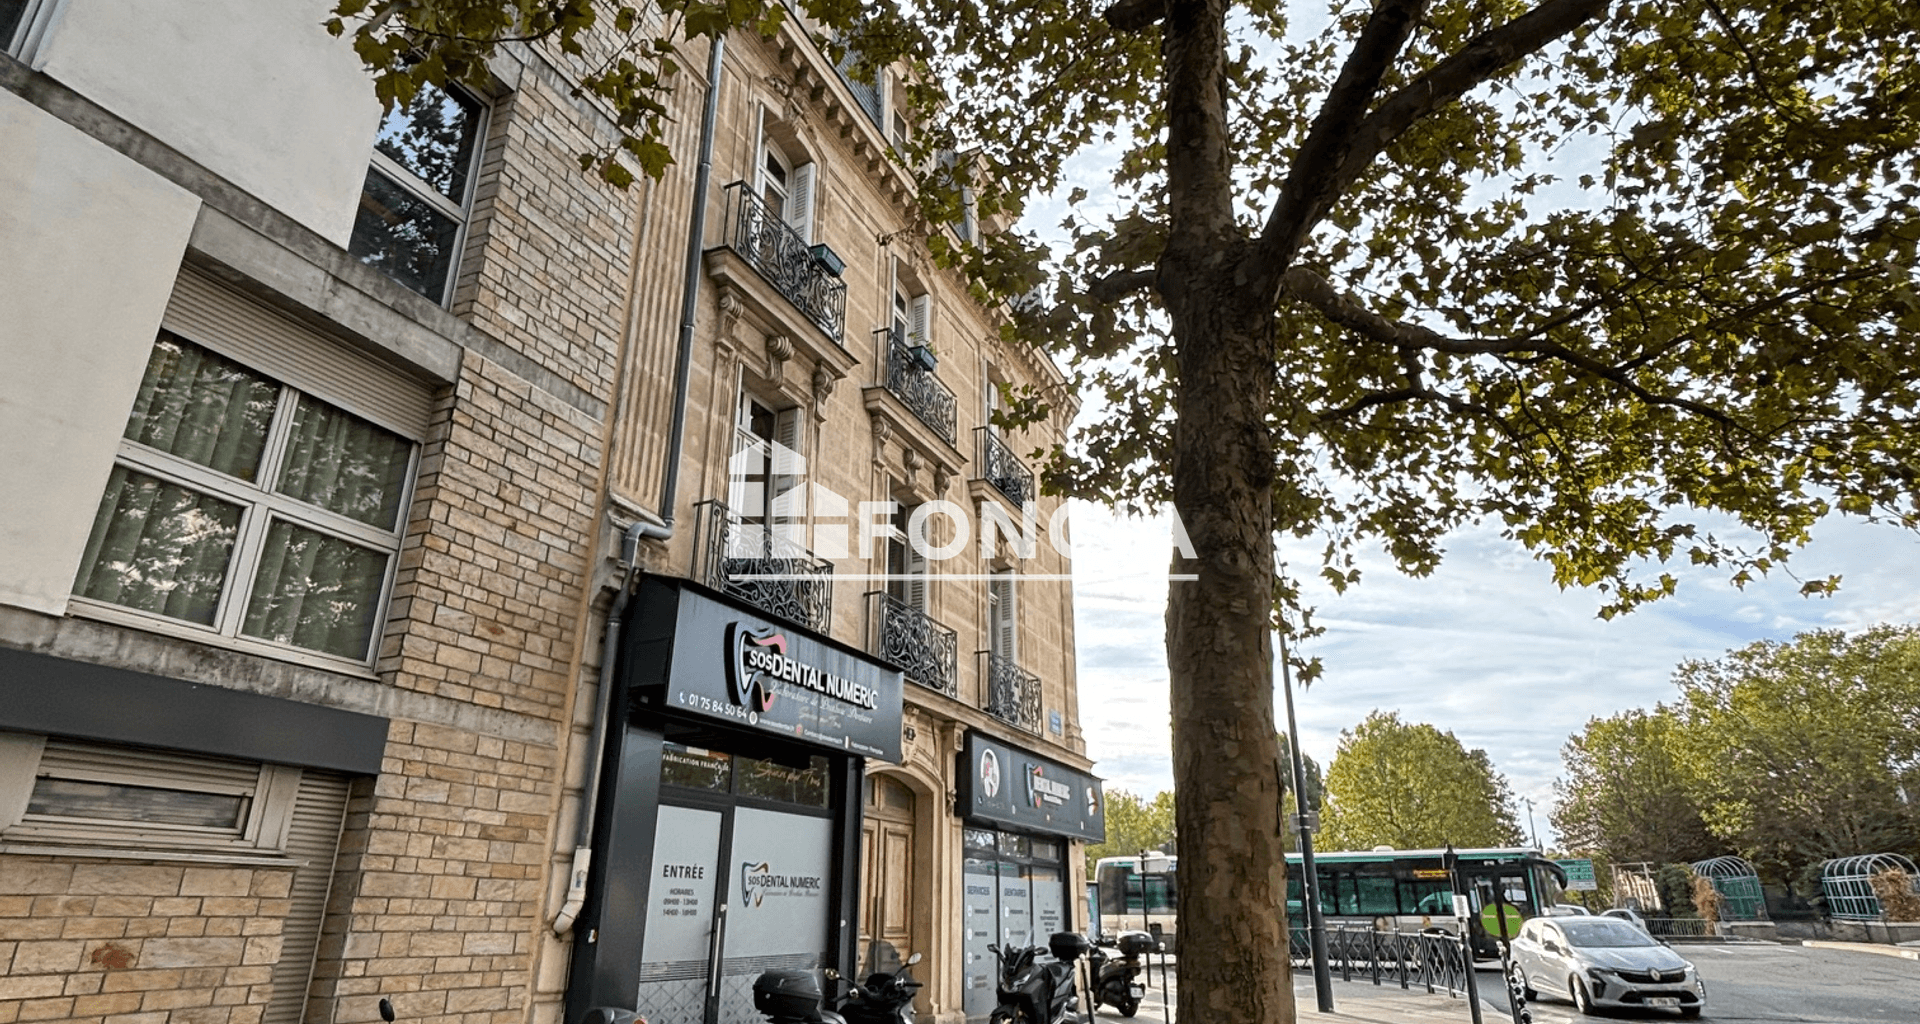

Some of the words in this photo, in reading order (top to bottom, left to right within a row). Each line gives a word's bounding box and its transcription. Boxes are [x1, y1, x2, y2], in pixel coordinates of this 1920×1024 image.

[826, 673, 878, 710] NUMERIC
[689, 693, 698, 707] 01
[701, 696, 710, 710] 75
[712, 700, 723, 713] 84
[725, 703, 735, 716] 50
[736, 706, 747, 719] 64
[663, 754, 700, 767] FABRICATION
[663, 863, 704, 879] ENTRÉE
[790, 875, 820, 889] NUMERIC
